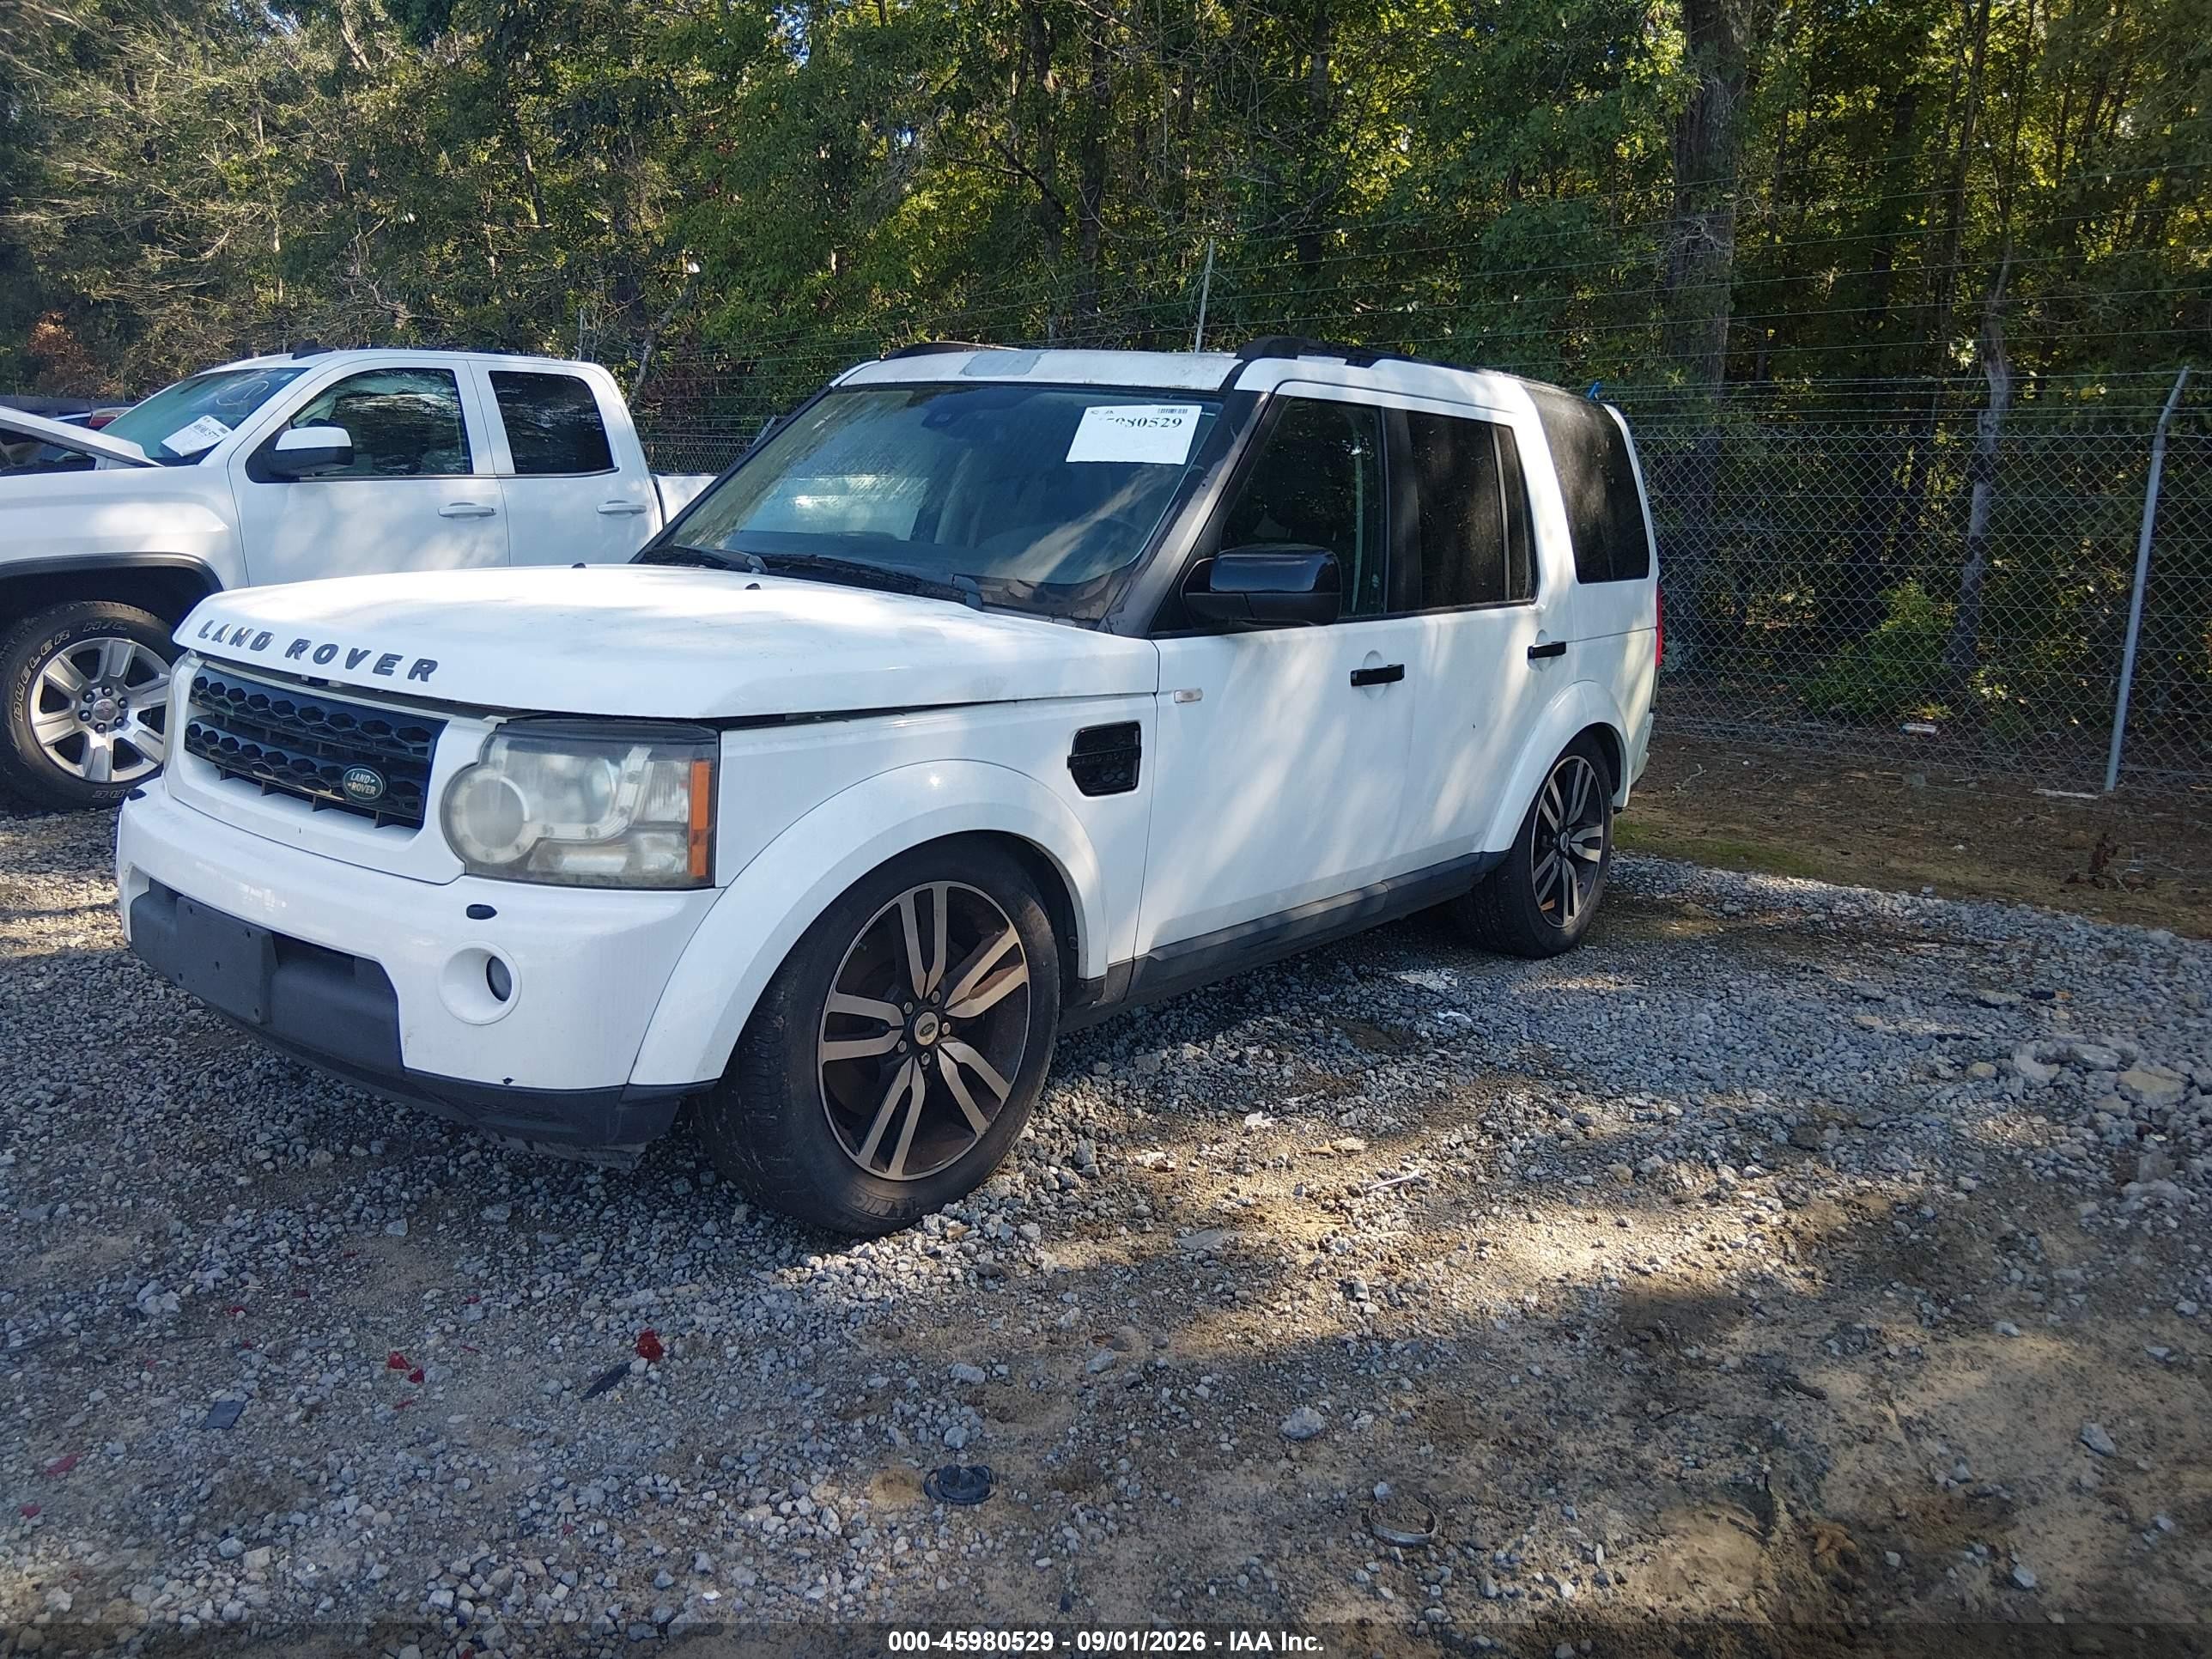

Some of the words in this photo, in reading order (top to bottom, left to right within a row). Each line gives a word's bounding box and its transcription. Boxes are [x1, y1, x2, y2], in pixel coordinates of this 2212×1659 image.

[1100, 417, 1182, 428] 80529
[198, 620, 274, 651] LAND
[285, 638, 439, 682] ROVER
[13, 630, 70, 721] DUELER
[350, 772, 371, 784] LAND
[351, 782, 376, 795] ROVER
